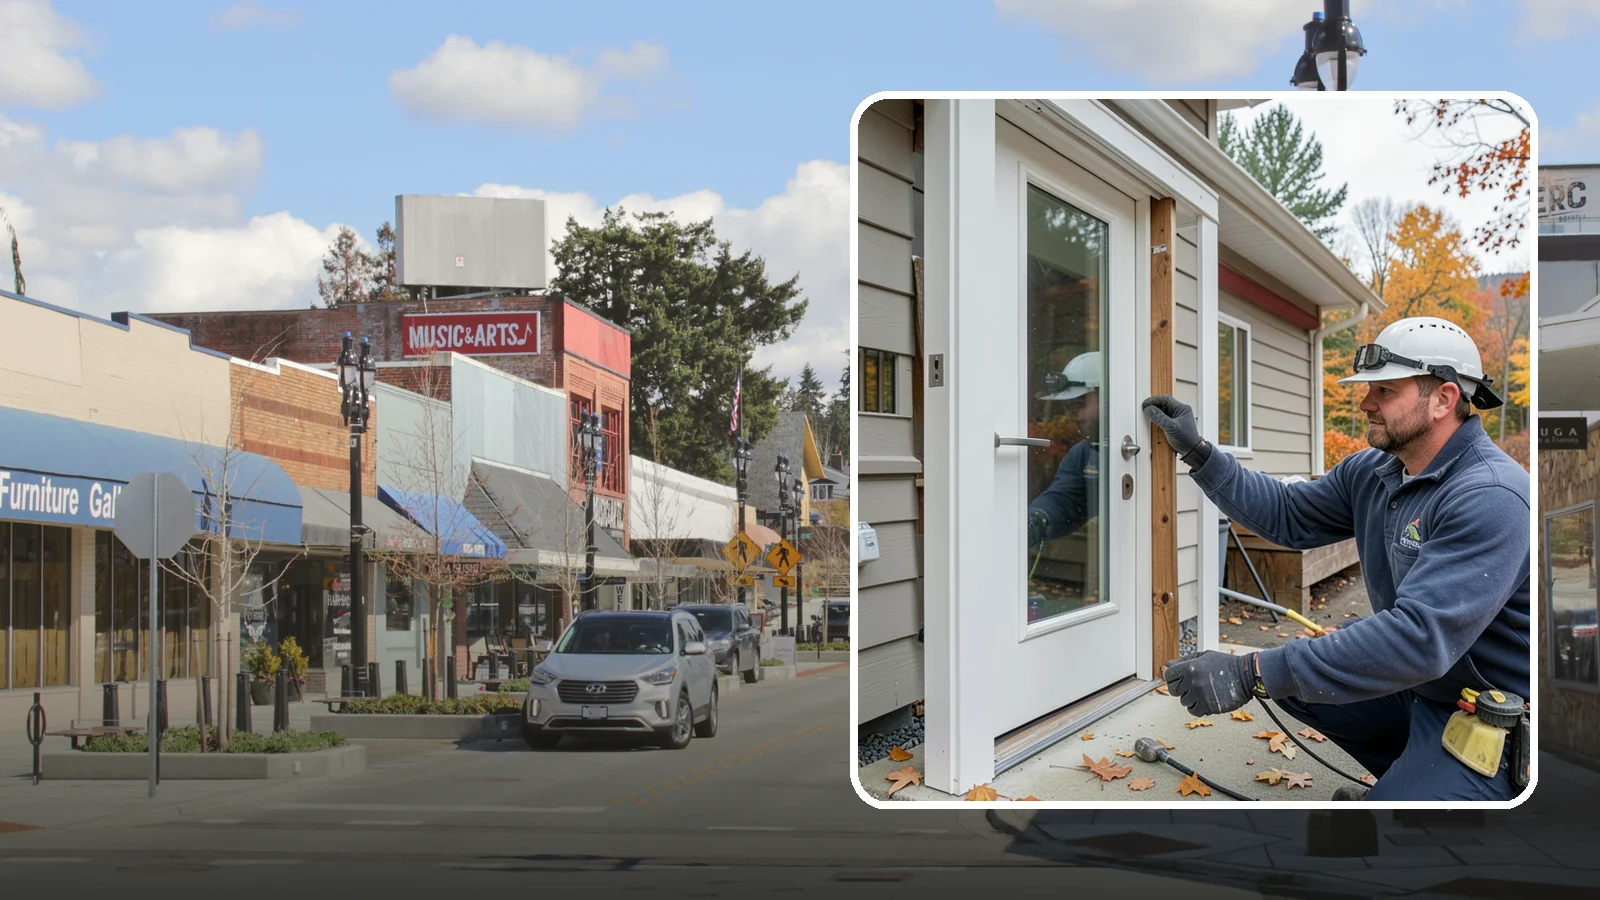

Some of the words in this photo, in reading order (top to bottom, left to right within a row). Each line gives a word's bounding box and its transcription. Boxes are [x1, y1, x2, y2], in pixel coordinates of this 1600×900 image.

[1540, 427, 1578, 437] UGA
[0, 471, 79, 516] Furniture
[89, 482, 122, 519] Gal
[453, 563, 480, 575] SUSHI
